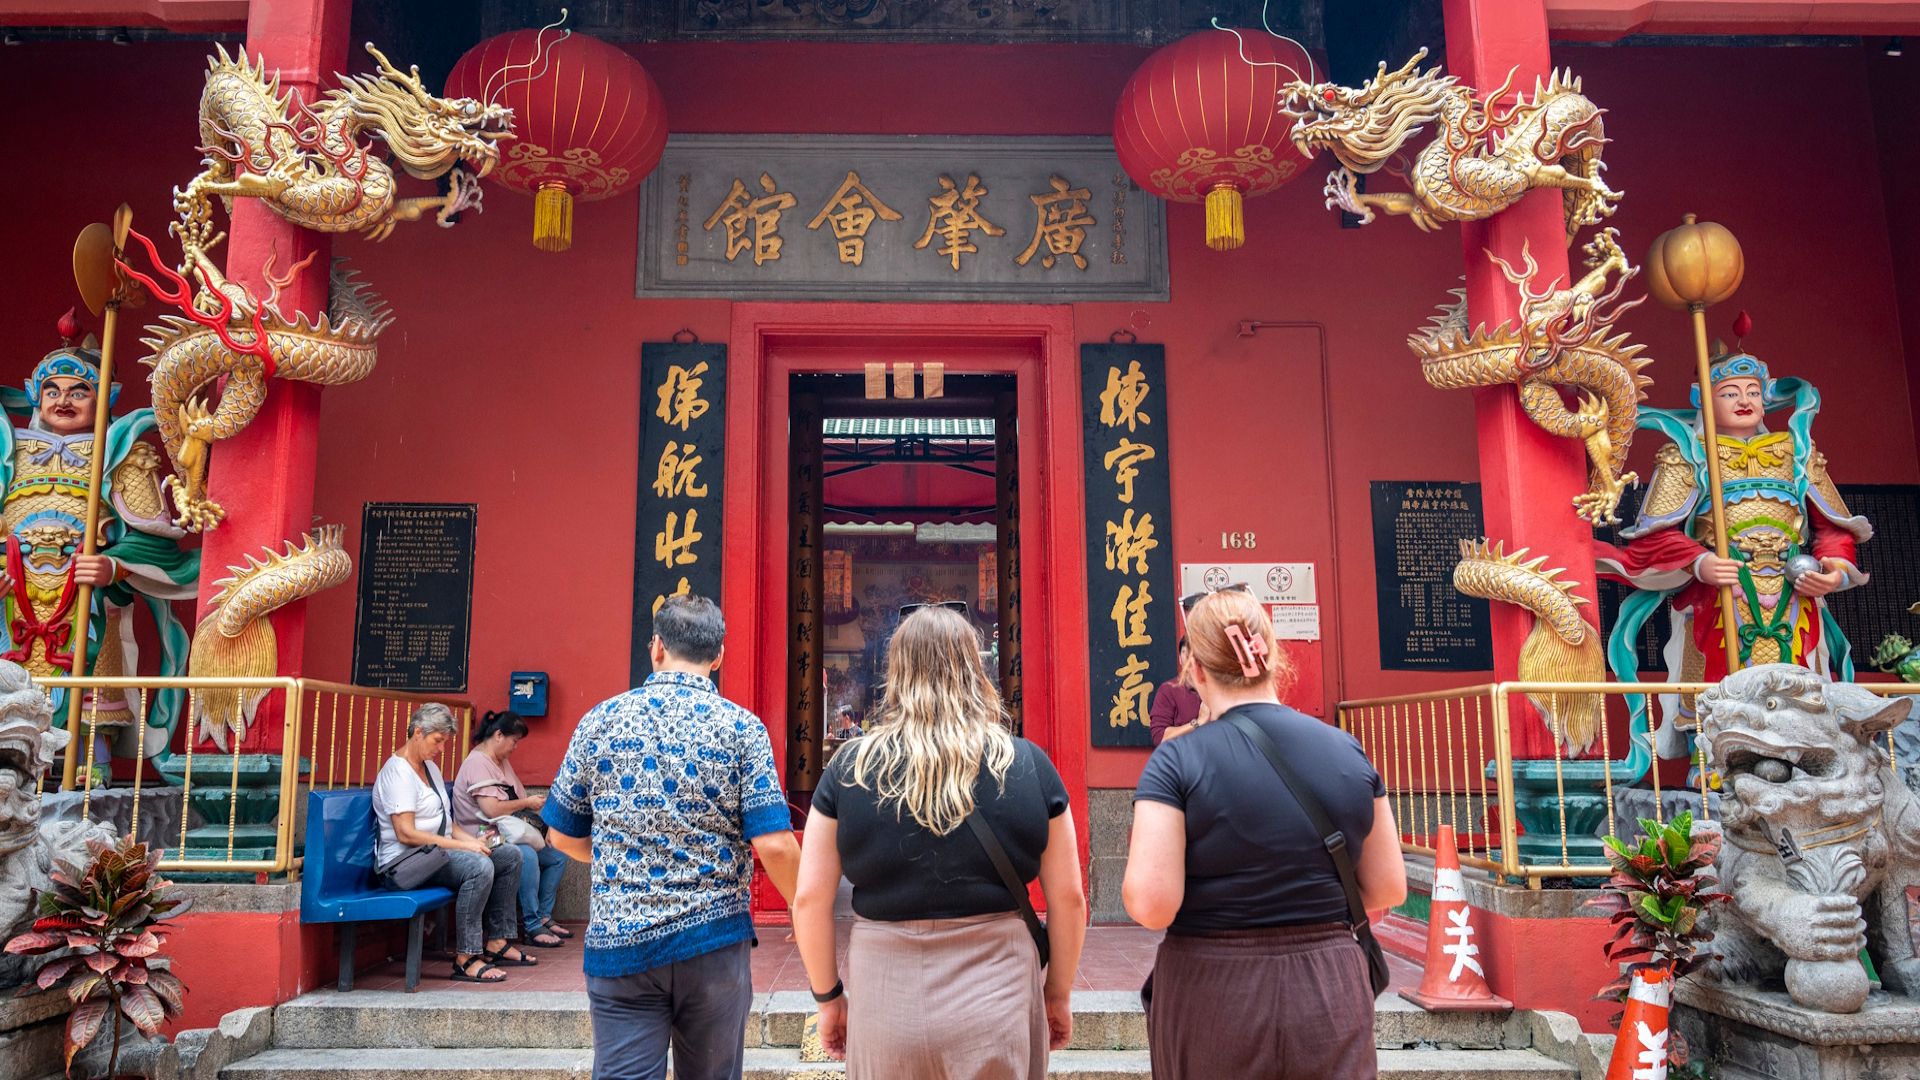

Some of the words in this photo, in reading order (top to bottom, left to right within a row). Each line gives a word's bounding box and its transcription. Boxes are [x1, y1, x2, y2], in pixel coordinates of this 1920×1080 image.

[703, 169, 1096, 272] 廣肇會館
[1220, 531, 1257, 550] 168
